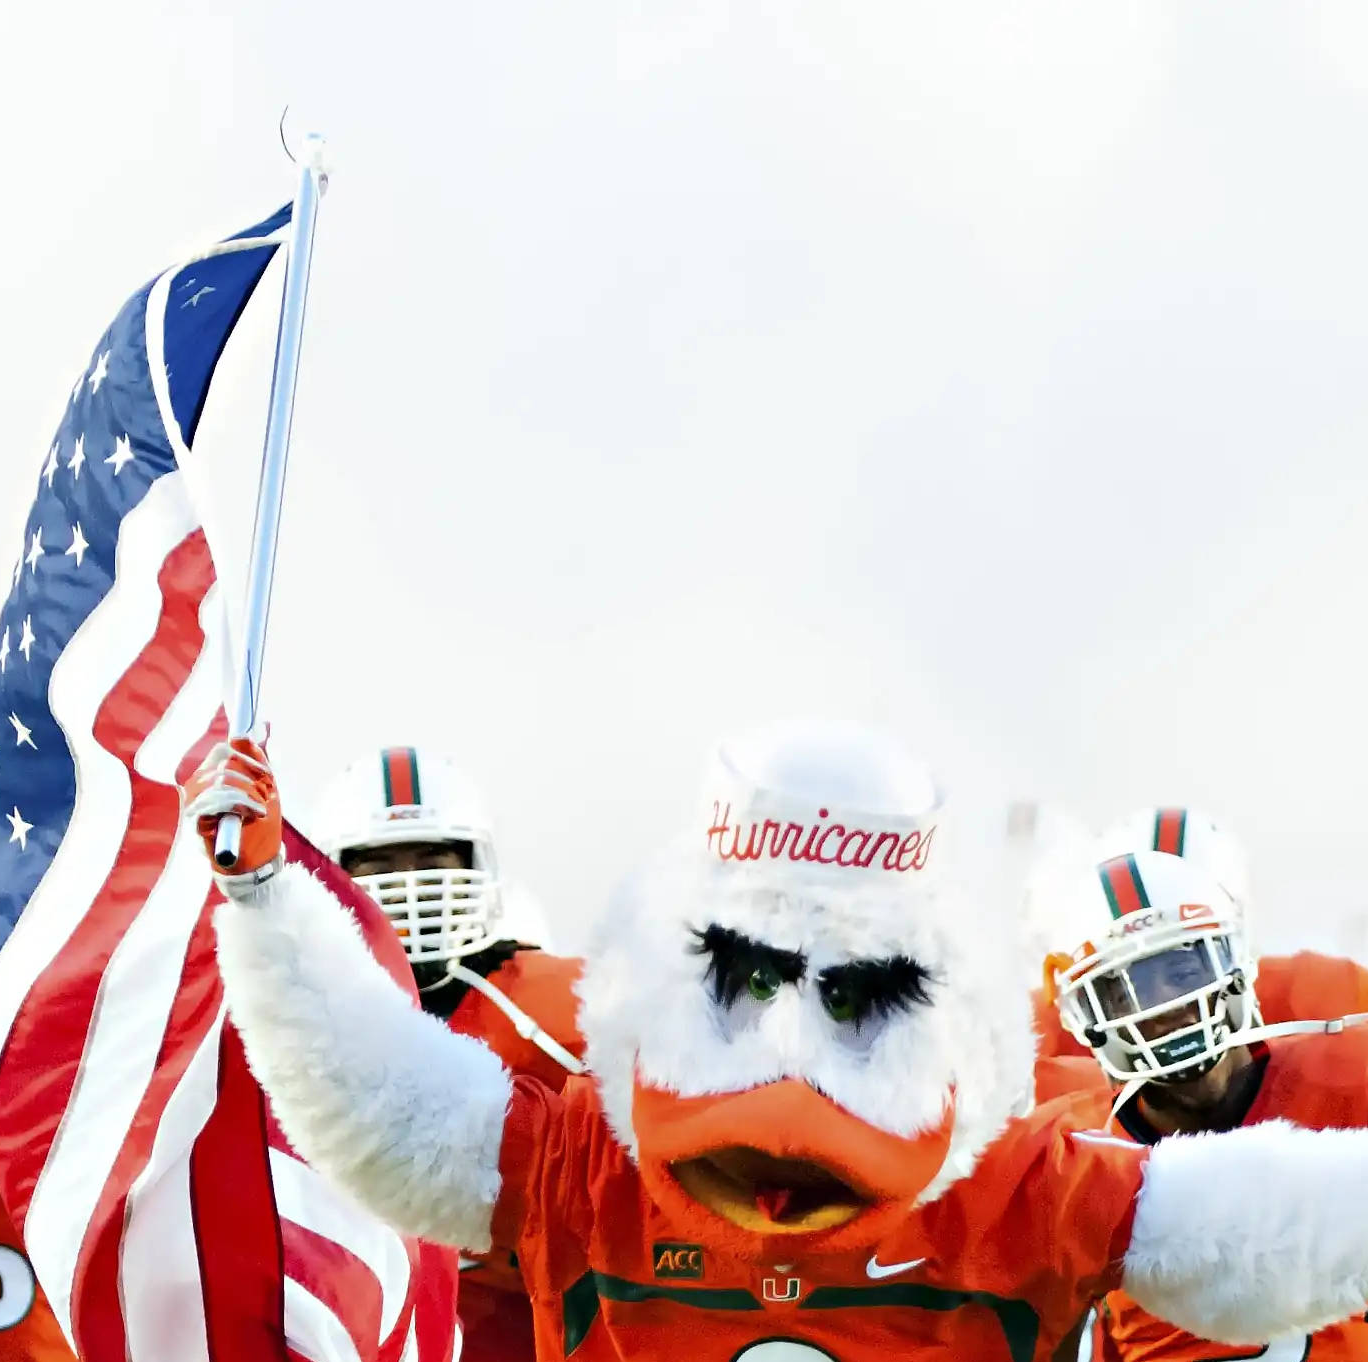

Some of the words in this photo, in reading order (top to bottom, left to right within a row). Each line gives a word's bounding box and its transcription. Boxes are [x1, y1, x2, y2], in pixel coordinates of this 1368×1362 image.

[707, 800, 937, 871] Hurricanes
[1123, 915, 1153, 933] ACC
[655, 1250, 700, 1271] ACC
[763, 1278, 800, 1302] U
